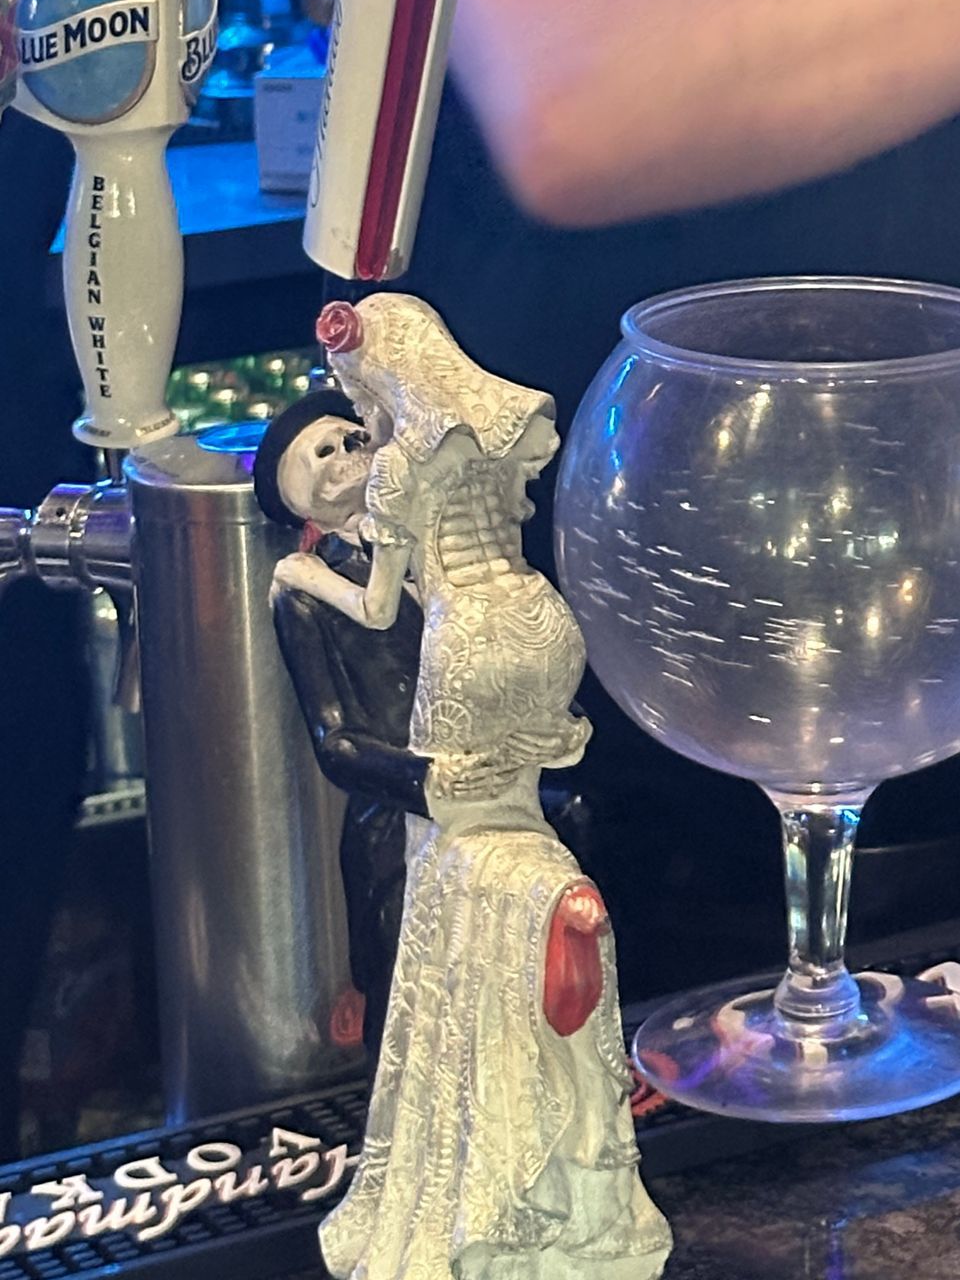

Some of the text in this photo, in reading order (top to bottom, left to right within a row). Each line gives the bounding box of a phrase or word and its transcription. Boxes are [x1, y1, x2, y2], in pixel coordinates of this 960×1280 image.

[21, 6, 150, 66] LUE MOON
[87, 175, 105, 305] BELGIAN
[88, 316, 112, 399] WHITE
[0, 1126, 321, 1222] VODK
